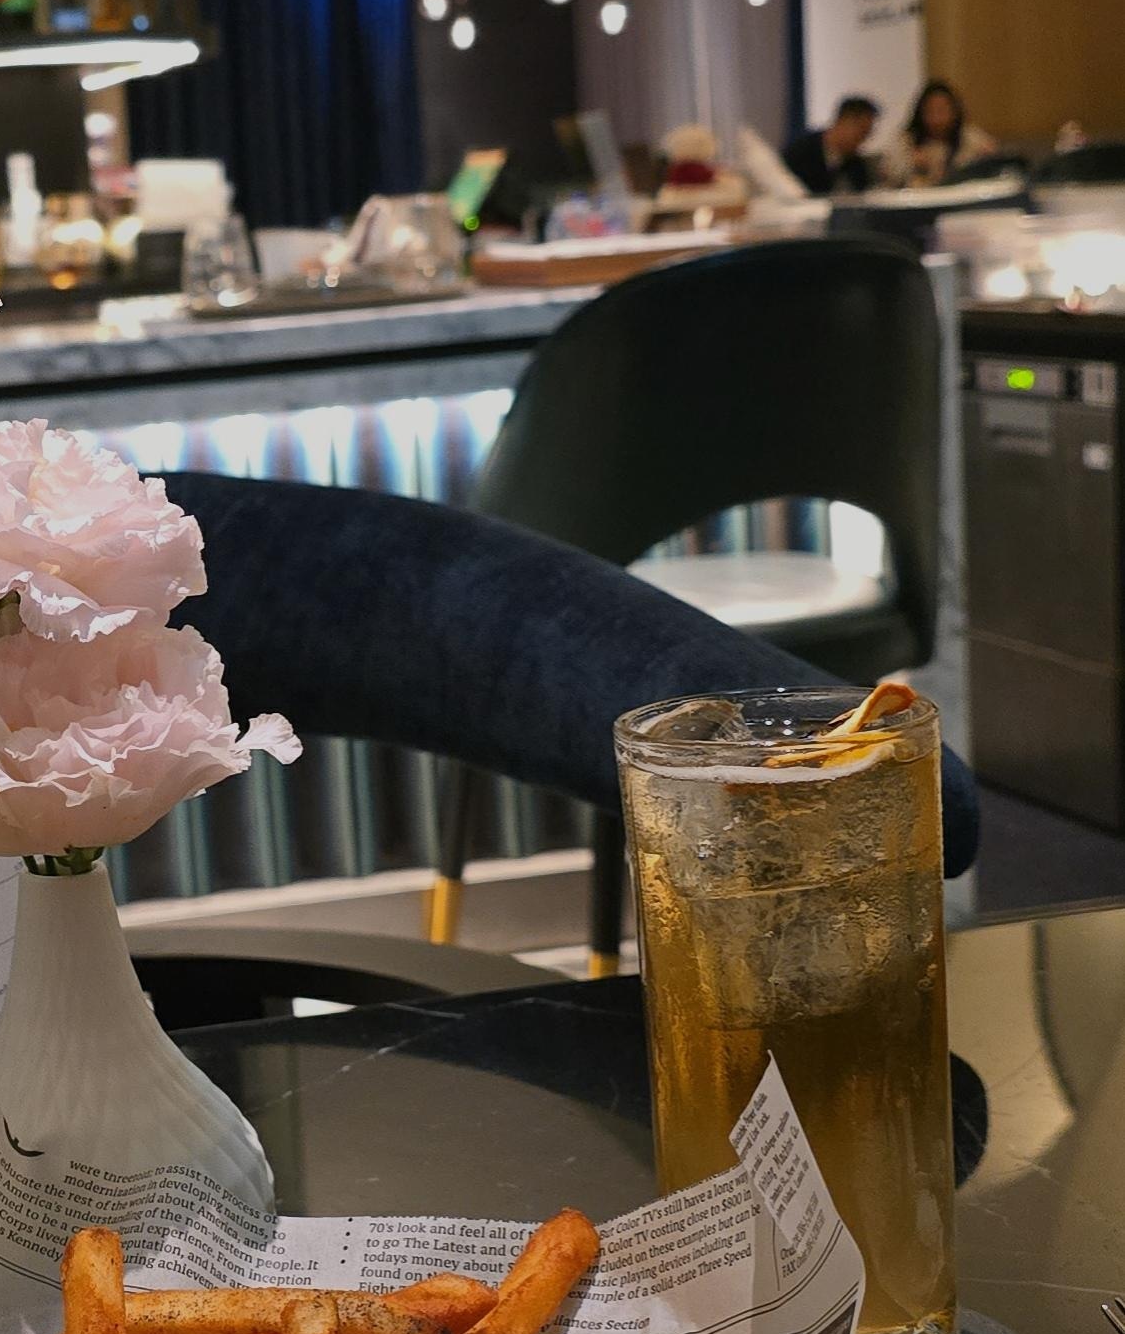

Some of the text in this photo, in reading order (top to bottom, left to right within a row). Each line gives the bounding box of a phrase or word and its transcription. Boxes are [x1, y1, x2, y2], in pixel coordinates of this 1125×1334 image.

[0, 1157, 286, 1255] educate the rest of the world about America, and to
[63, 1173, 148, 1197] modernization
[159, 1178, 223, 1213] developing
[224, 1208, 269, 1239] nations,
[272, 1230, 286, 1241] to
[70, 1160, 101, 1178] were
[167, 1165, 202, 1183] assist
[204, 1174, 221, 1194] the
[222, 1188, 260, 1221] process
[366, 1238, 380, 1249] to
[383, 1239, 400, 1251] go
[402, 1237, 430, 1250] The
[434, 1240, 477, 1255] Latest
[480, 1244, 506, 1256] and
[607, 1237, 633, 1255] Color
[635, 1230, 650, 1245] TV
[650, 1217, 686, 1239] costing
[687, 1209, 709, 1227] close
[710, 1203, 720, 1216] to
[743, 1188, 752, 1201] in
[370, 1223, 395, 1234] 70's
[396, 1222, 426, 1234] look
[426, 1225, 456, 1236] and
[459, 1226, 486, 1238] feel
[489, 1227, 507, 1239] all
[510, 1228, 525, 1240] of
[617, 1216, 641, 1235] Color
[642, 1210, 663, 1225] TV's
[664, 1201, 683, 1217] still
[684, 1193, 707, 1210] have
[707, 1189, 713, 1199] a
[714, 1179, 735, 1198] long
[0, 1208, 34, 1235] Corps
[36, 1226, 69, 1247] lived
[188, 1254, 209, 1270] and
[210, 1263, 227, 1283] has
[2, 1180, 63, 1214] America's
[64, 1207, 144, 1225] understanding
[145, 1207, 160, 1218] of
[161, 1208, 182, 1223] the
[185, 1216, 254, 1264] non-western
[256, 1255, 305, 1273] people.
[307, 1258, 318, 1271] It
[7, 1230, 64, 1263] Kennedy
[123, 1254, 155, 1269] uring
[158, 1259, 218, 1291] achievem
[26, 1207, 40, 1220] to
[42, 1213, 58, 1226] be
[60, 1221, 69, 1230] a
[147, 1223, 214, 1257] experience.
[217, 1251, 246, 1277] From
[249, 1267, 312, 1286] inception
[360, 1230, 747, 1288] found on music playing devices including an
[363, 1203, 762, 1274] todays money about included on these examples but can be
[568, 1289, 625, 1304] example
[627, 1287, 640, 1301] of
[642, 1286, 649, 1297] a
[651, 1268, 696, 1295] solid-state
[697, 1258, 723, 1277] Three
[723, 1243, 753, 1266] Speed
[604, 1317, 651, 1331] Section
